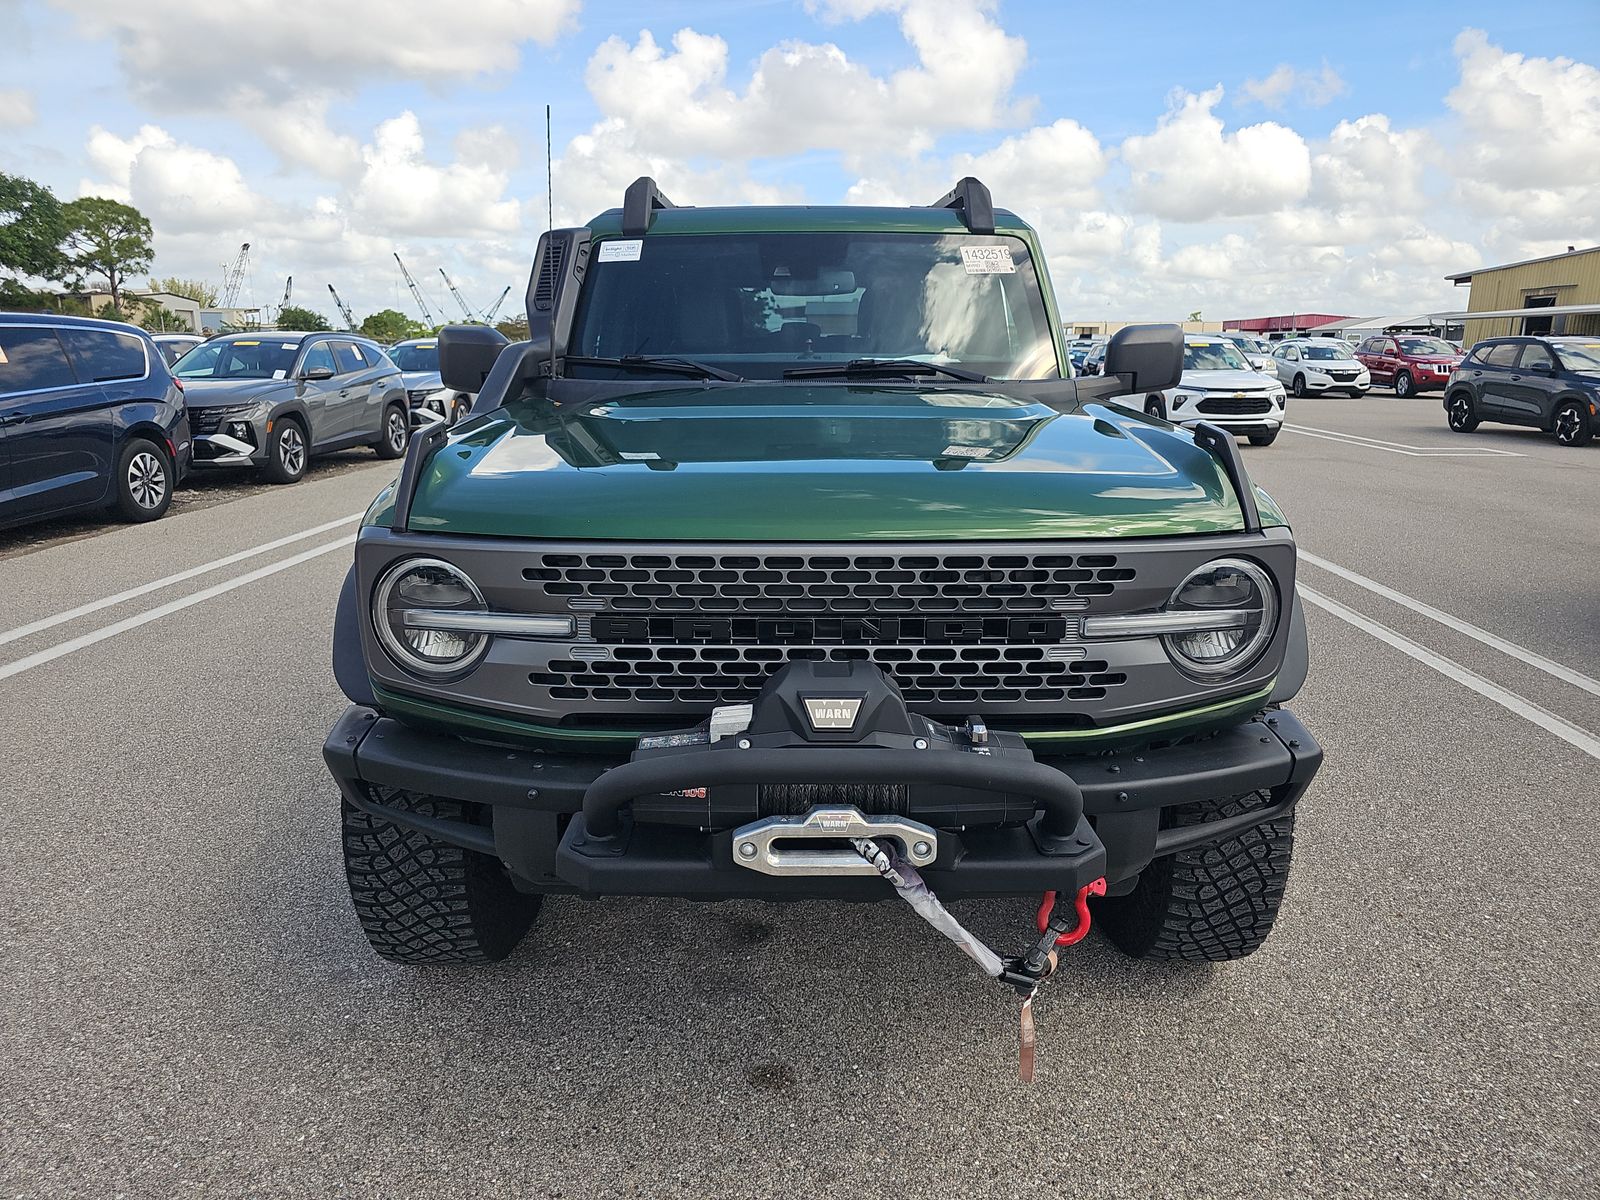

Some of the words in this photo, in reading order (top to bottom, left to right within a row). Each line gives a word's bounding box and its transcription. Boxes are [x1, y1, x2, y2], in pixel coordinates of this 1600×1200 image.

[965, 249, 1011, 260] 1432519
[591, 617, 1066, 640] BRONCO
[815, 708, 851, 719] WARN
[822, 820, 847, 828] WARN
